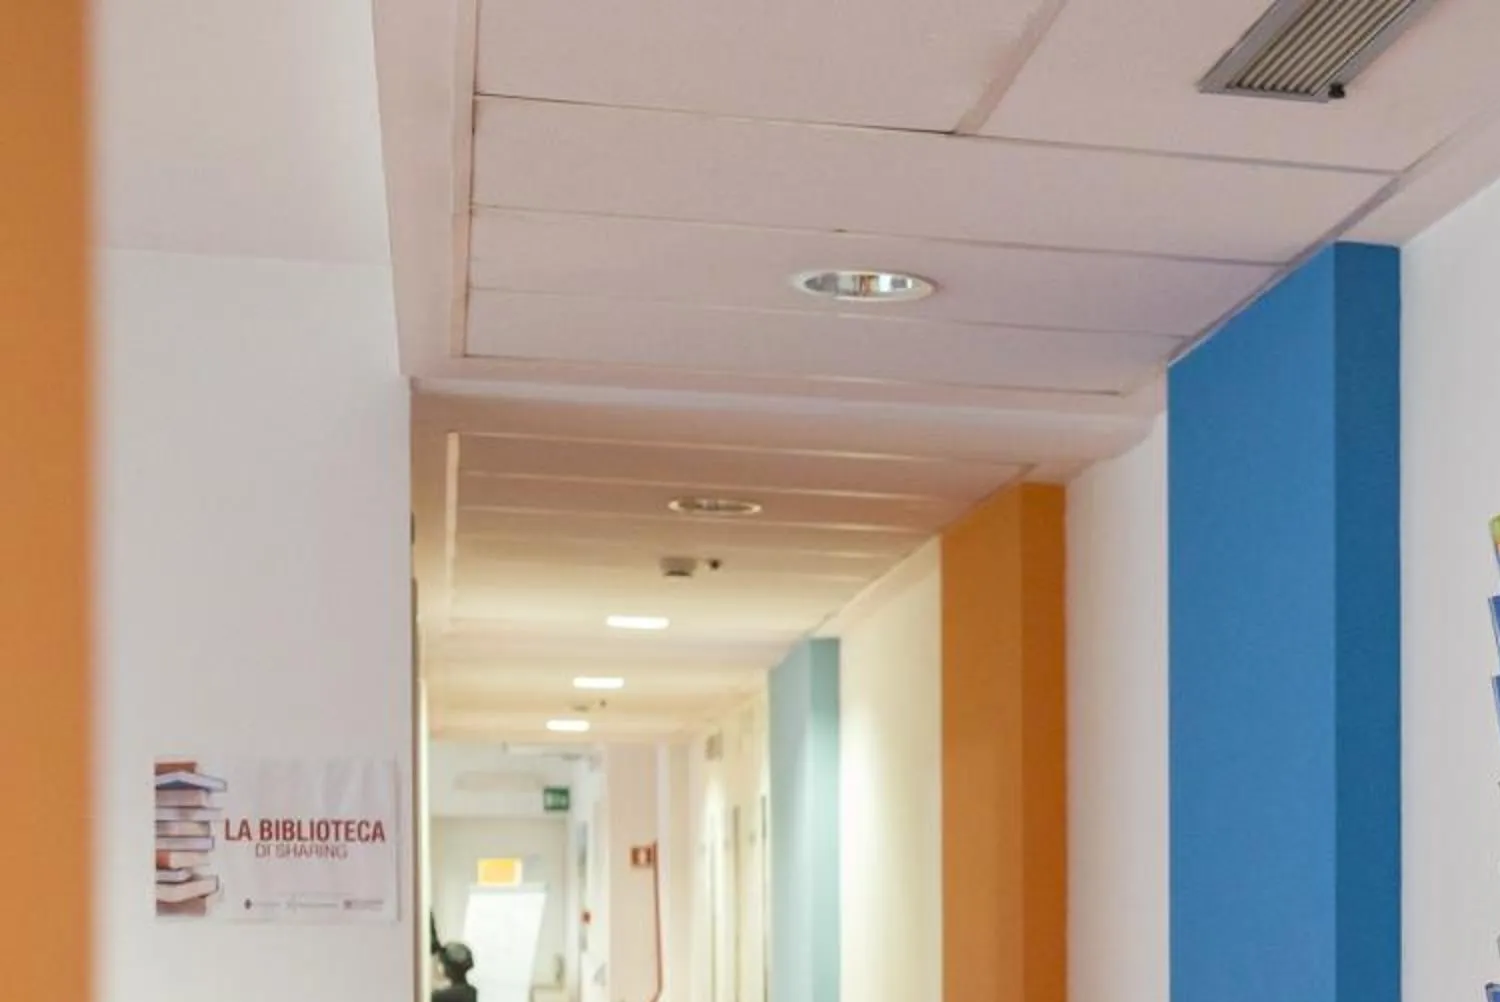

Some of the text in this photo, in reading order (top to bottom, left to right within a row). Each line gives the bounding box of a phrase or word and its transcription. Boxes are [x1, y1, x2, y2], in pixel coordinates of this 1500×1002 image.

[224, 818, 386, 843] LA BIBLIOTECA
[275, 844, 349, 860] SHARING
